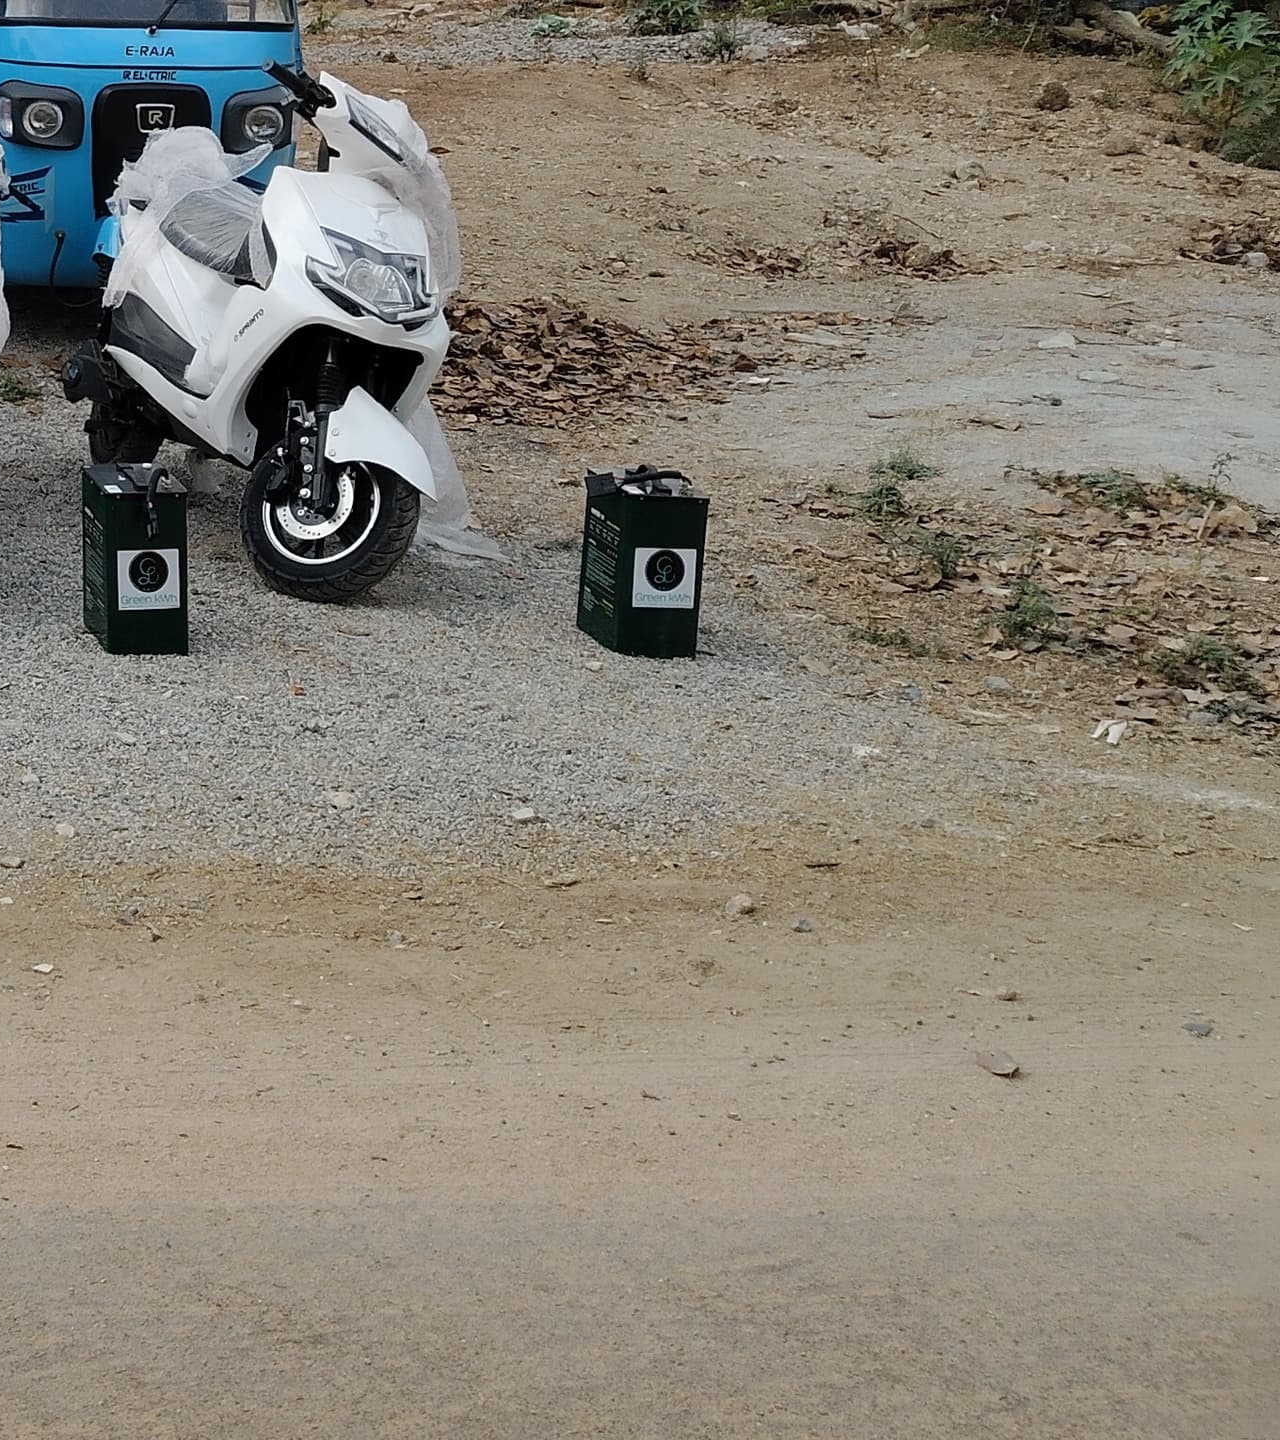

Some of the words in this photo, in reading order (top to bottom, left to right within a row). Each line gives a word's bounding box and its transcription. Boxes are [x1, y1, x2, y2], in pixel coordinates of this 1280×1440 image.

[125, 45, 175, 57] E-RAJA
[120, 595, 153, 606] Green
[154, 594, 178, 605] kWh
[635, 592, 666, 603] Green
[668, 593, 691, 604] kWh
